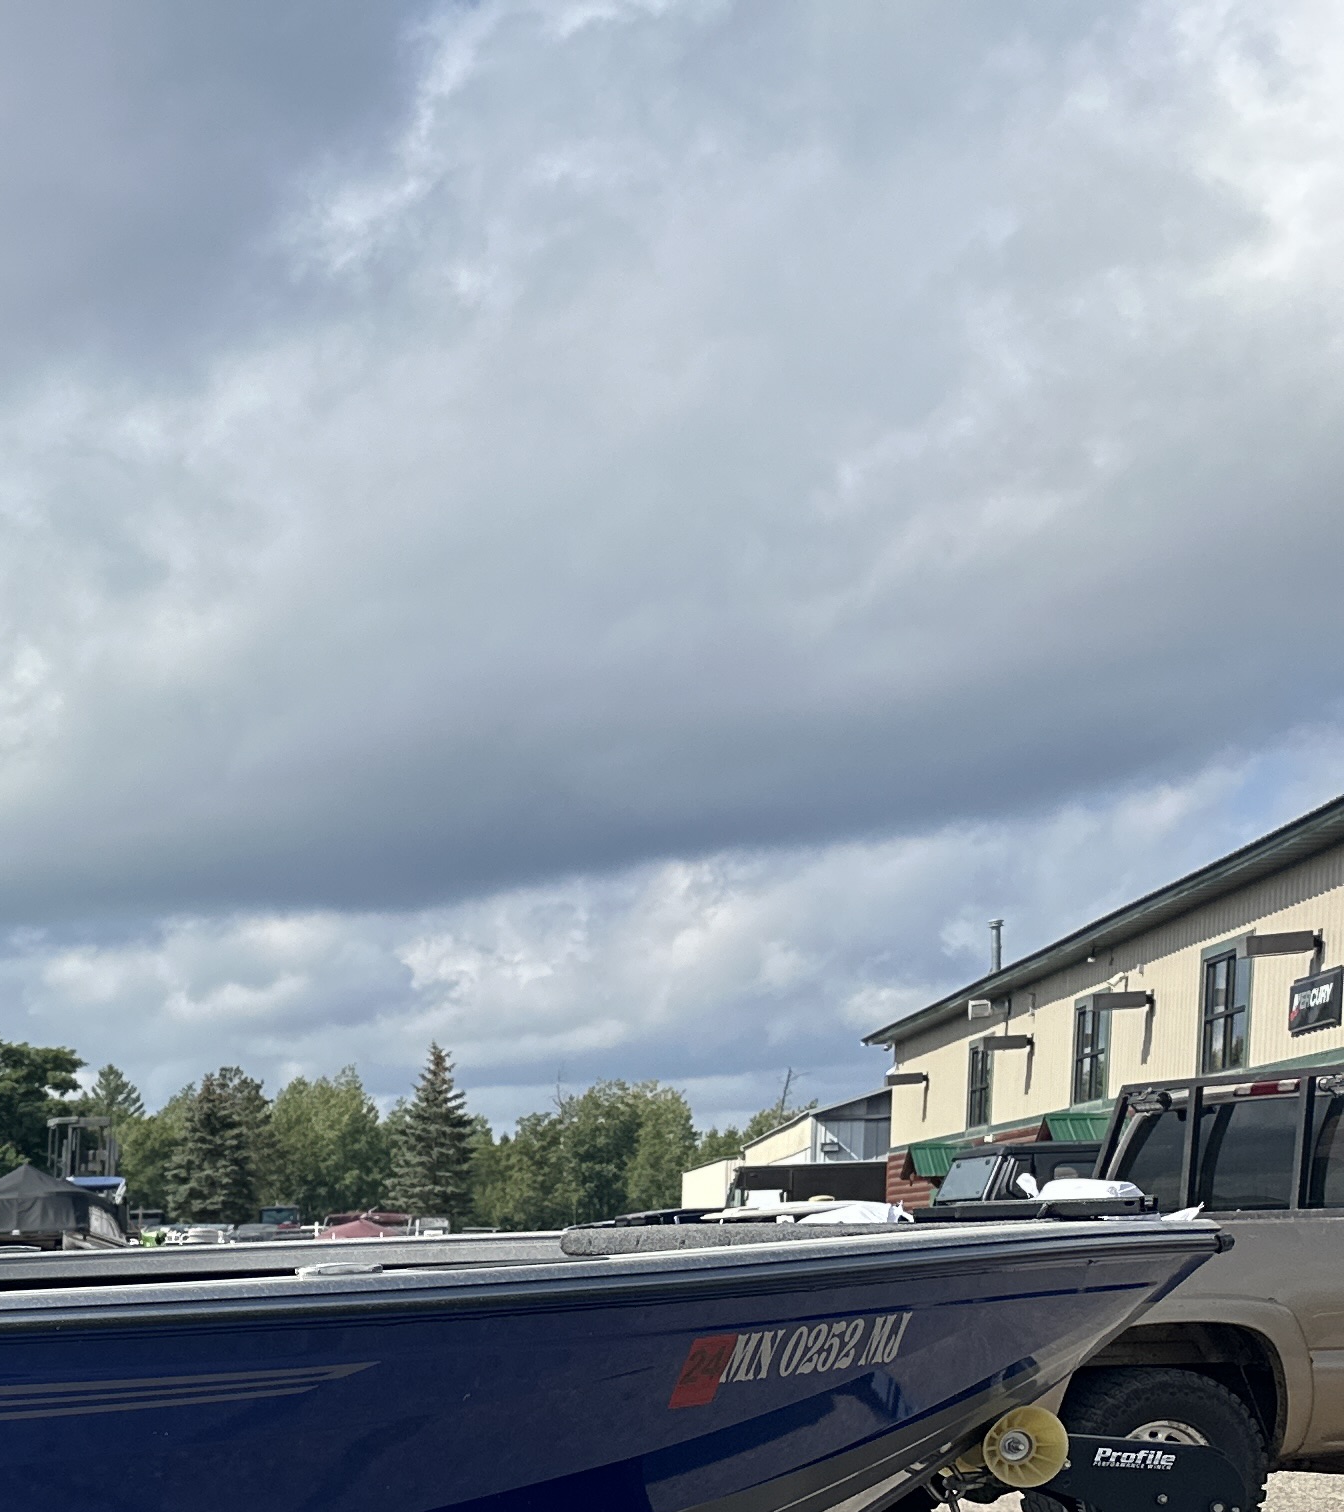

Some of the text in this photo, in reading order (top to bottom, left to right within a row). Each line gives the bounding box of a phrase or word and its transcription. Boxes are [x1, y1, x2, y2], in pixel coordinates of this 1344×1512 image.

[719, 1311, 912, 1383] MN 0252 MJ
[1094, 1447, 1176, 1466] Profile
